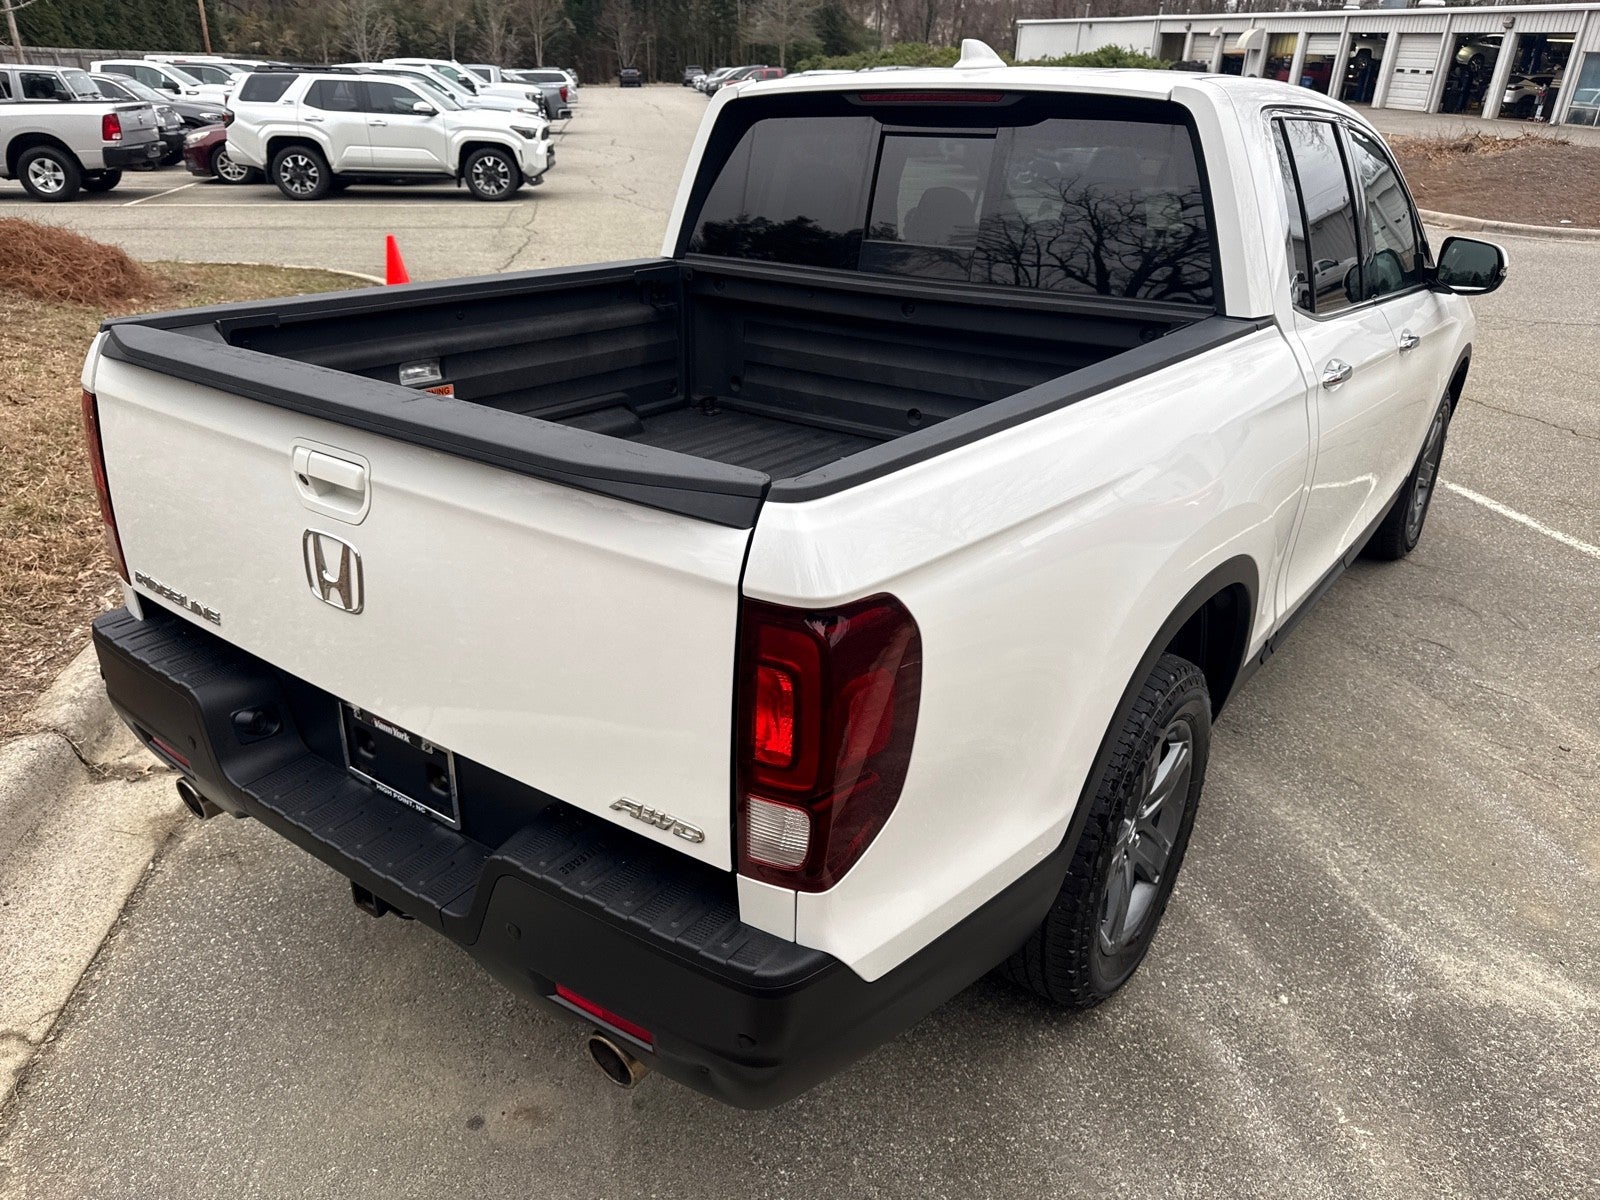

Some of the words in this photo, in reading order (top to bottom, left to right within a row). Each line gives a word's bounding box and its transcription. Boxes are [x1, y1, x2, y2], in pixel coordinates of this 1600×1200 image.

[373, 718, 393, 735] Vann
[391, 726, 411, 743] York
[376, 783, 393, 797] HIGH
[608, 796, 706, 844] AWD
